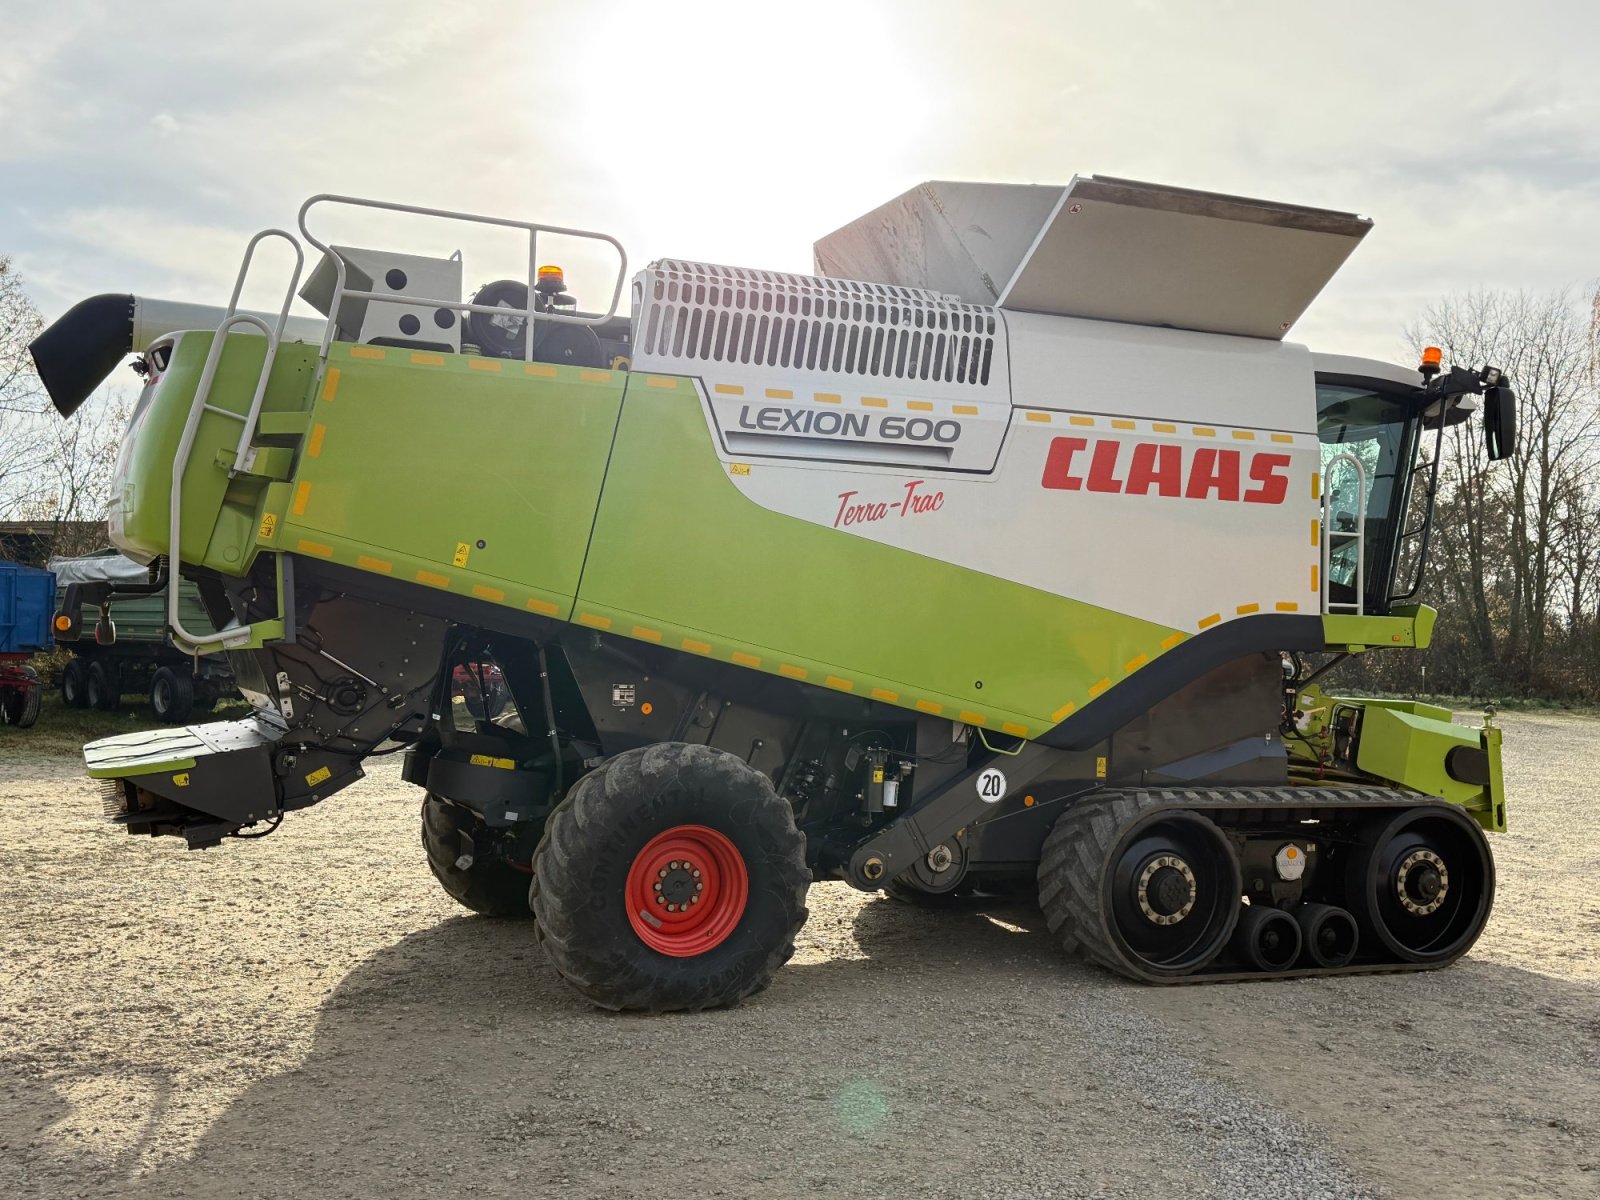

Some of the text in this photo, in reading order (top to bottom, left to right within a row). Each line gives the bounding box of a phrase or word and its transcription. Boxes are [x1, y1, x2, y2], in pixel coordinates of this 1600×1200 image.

[738, 405, 962, 443] LEXION 600
[1041, 436, 1291, 504] CLAAS
[834, 480, 944, 528] Terra-Trac
[982, 774, 1001, 797] 20
